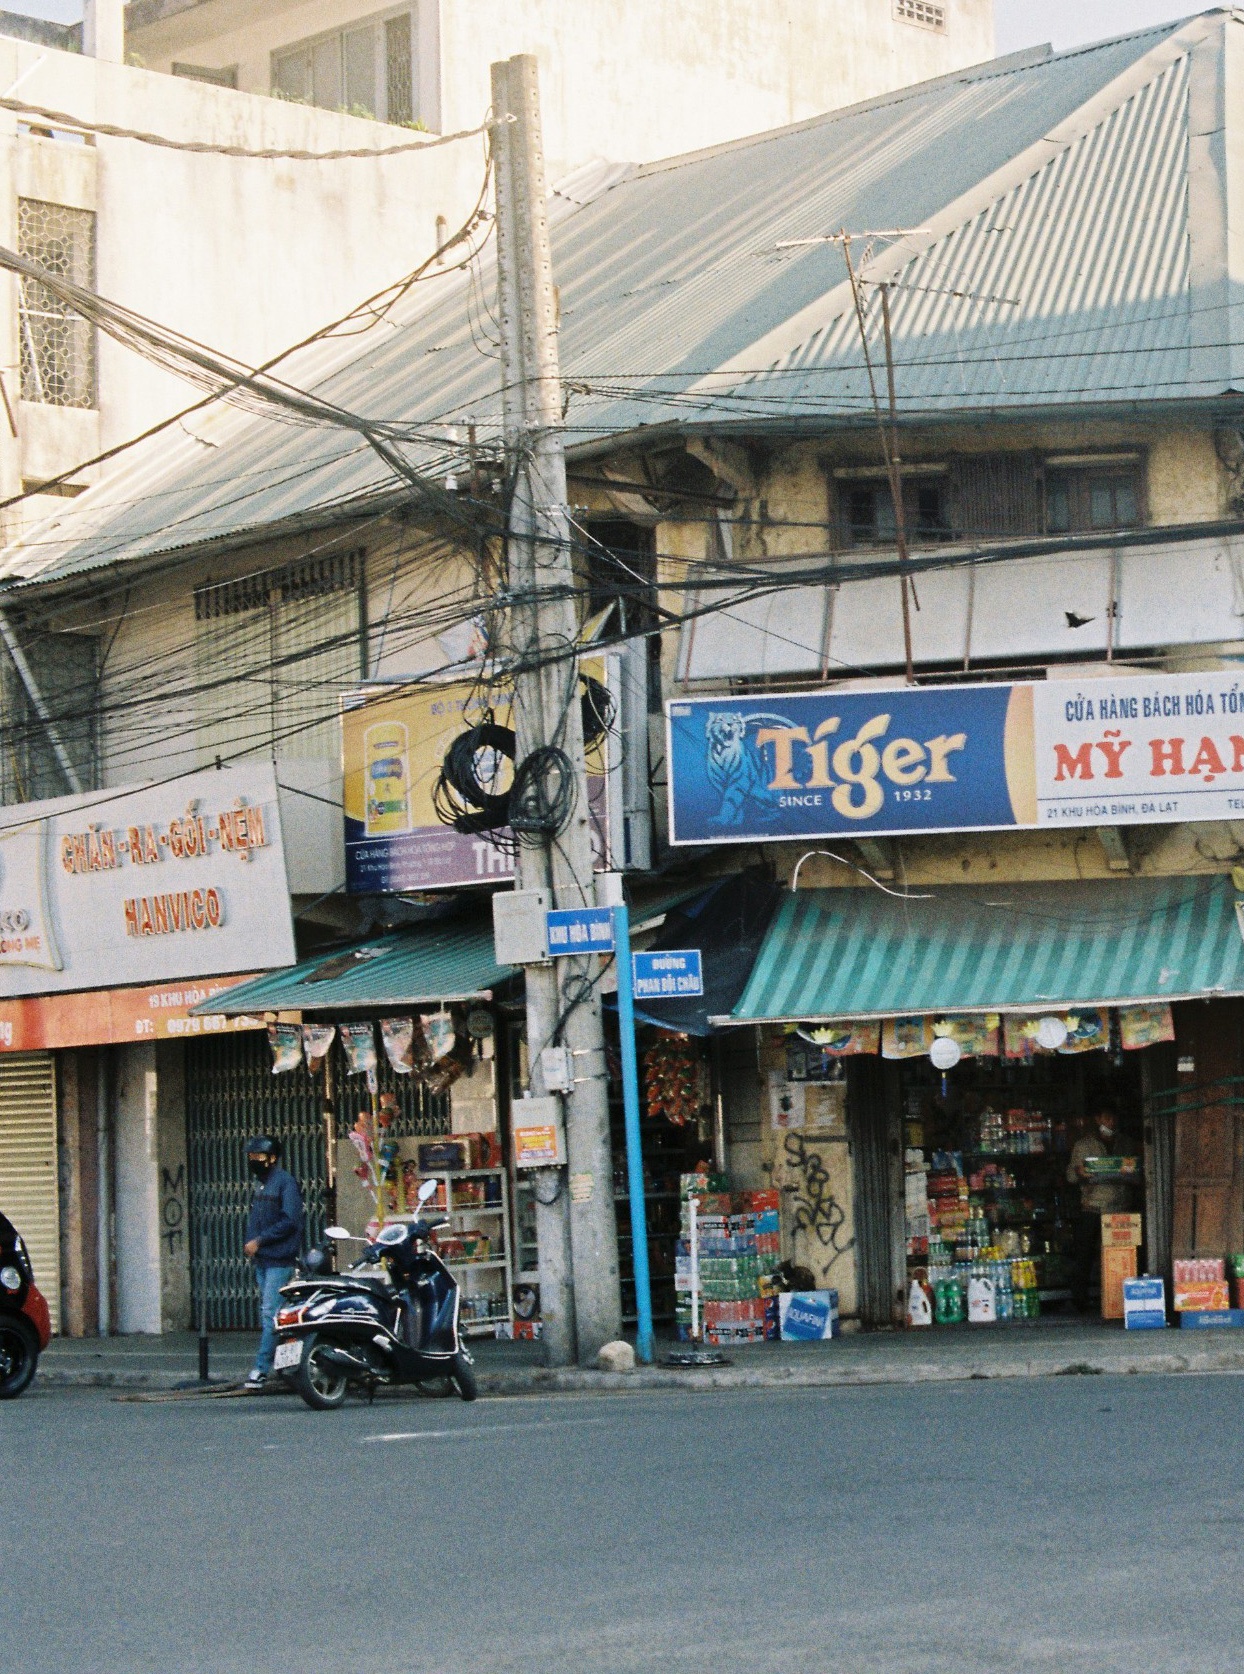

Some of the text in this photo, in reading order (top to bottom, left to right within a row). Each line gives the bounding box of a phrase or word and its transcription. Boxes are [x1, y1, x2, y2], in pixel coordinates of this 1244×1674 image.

[1065, 693, 1095, 722] CỬA
[1100, 693, 1138, 720] HÀNG
[1143, 691, 1181, 717] BÁCH
[1185, 689, 1215, 716] HÓA
[756, 713, 967, 820] Tiger
[1053, 729, 1132, 781] MỸ
[779, 790, 932, 807] SINCE 1932
[1047, 808, 1058, 818] 21
[1061, 806, 1083, 817] KHU
[124, 887, 222, 937] HANVICO
[160, 991, 182, 1007] KHU
